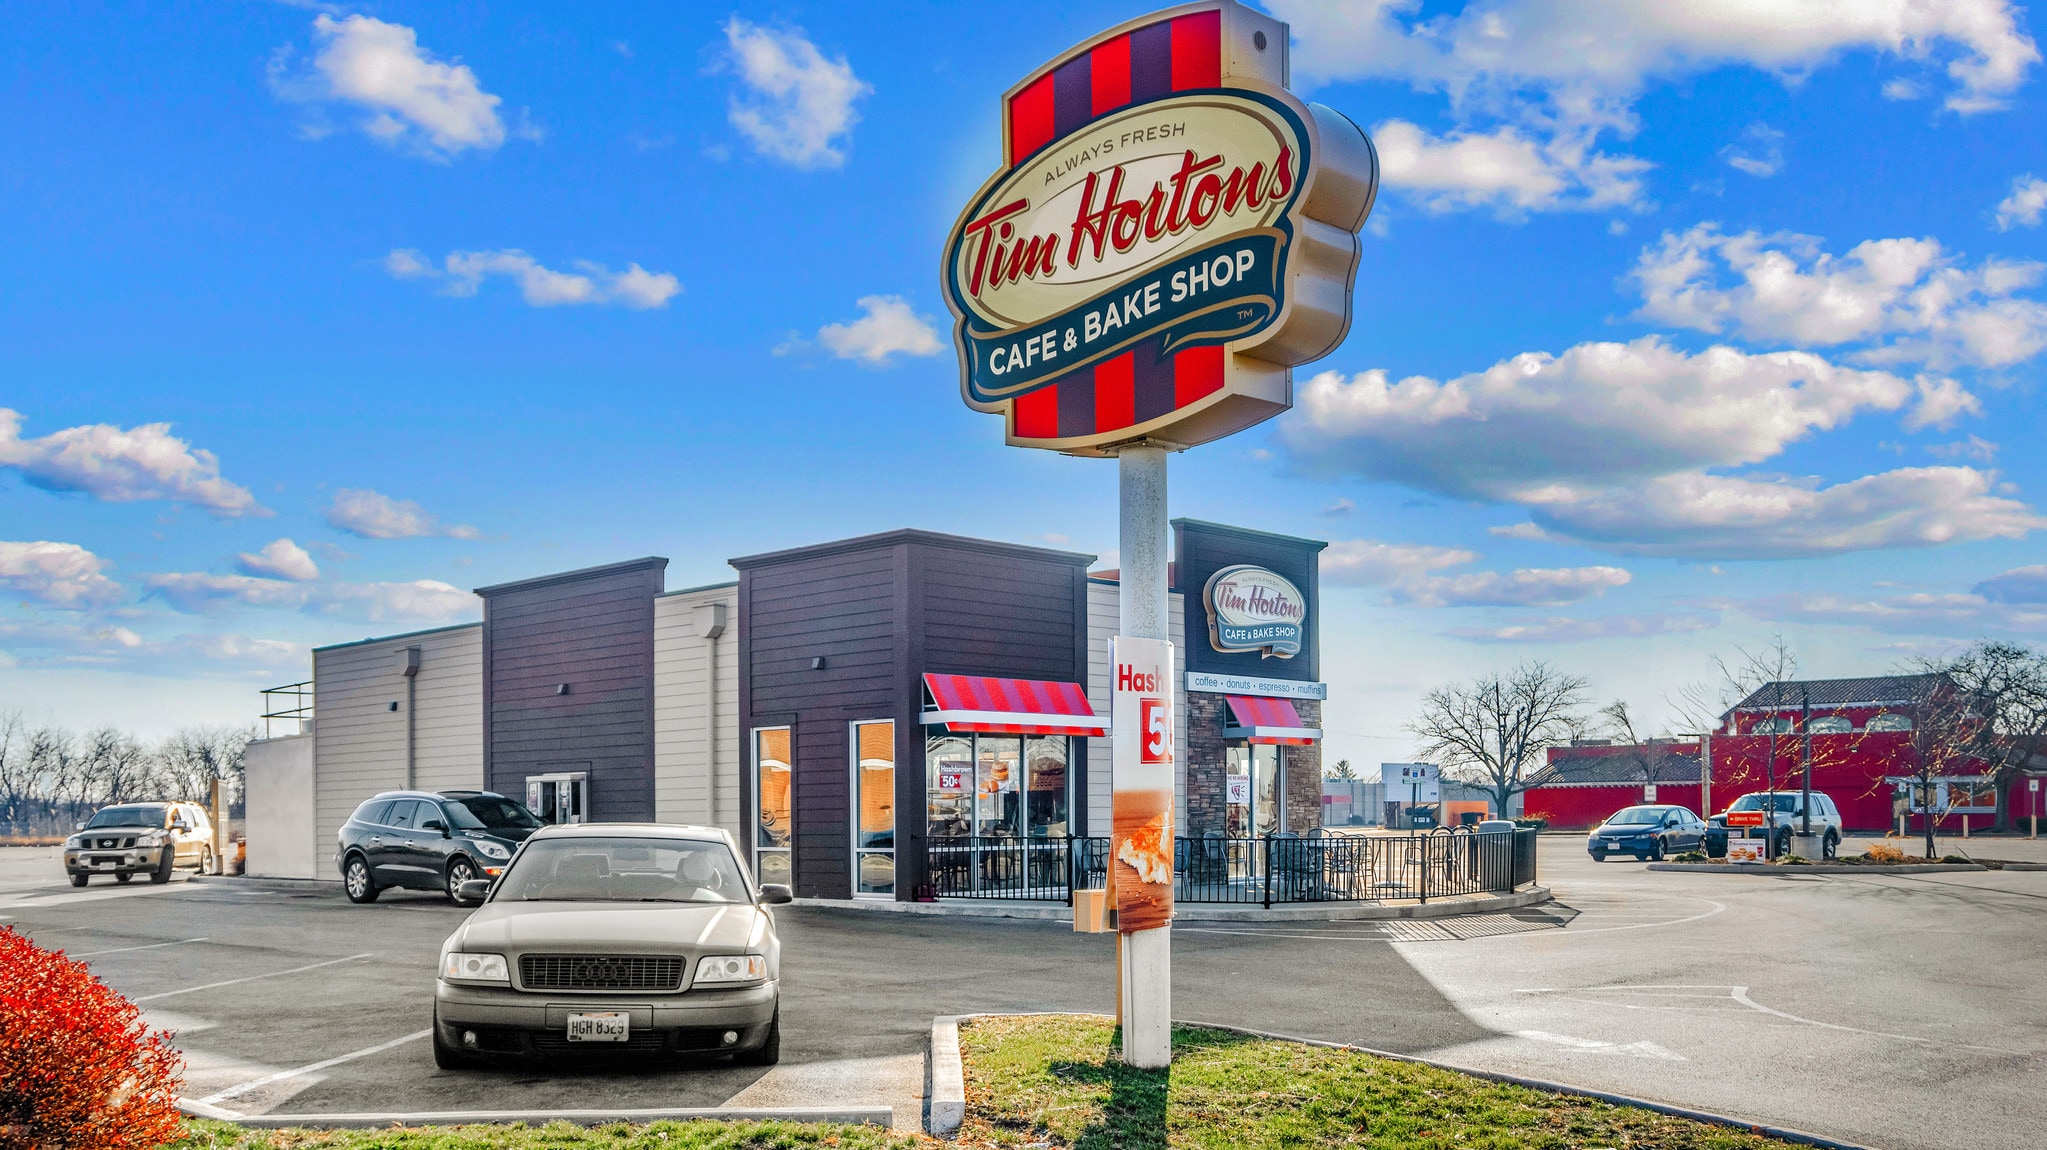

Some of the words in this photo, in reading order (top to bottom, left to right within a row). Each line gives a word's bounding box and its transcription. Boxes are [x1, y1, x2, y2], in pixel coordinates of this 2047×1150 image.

[1044, 140, 1114, 187] ALWAYS
[1121, 122, 1186, 149] FRESH
[964, 197, 1060, 300] Tim
[1067, 144, 1295, 270] Hortons
[989, 329, 1057, 375] CAFE
[1063, 327, 1078, 352] &
[1084, 281, 1161, 344] BAKE
[1171, 249, 1255, 302] SHOP
[1237, 309, 1253, 320] TM
[1262, 577, 1280, 587] FRESH
[1217, 581, 1247, 612] Tim
[1248, 584, 1303, 618] Hortons
[1225, 628, 1246, 640] CAFE
[1247, 631, 1252, 639] &
[1253, 627, 1274, 639] BAKE
[1275, 627, 1296, 638] SHOP
[1195, 676, 1218, 688] coffee
[1226, 678, 1251, 690] donuts
[1258, 682, 1290, 693] espresso
[1297, 685, 1322, 695] muffins
[571, 1020, 593, 1035] HGH
[596, 1020, 624, 1035] 8329
